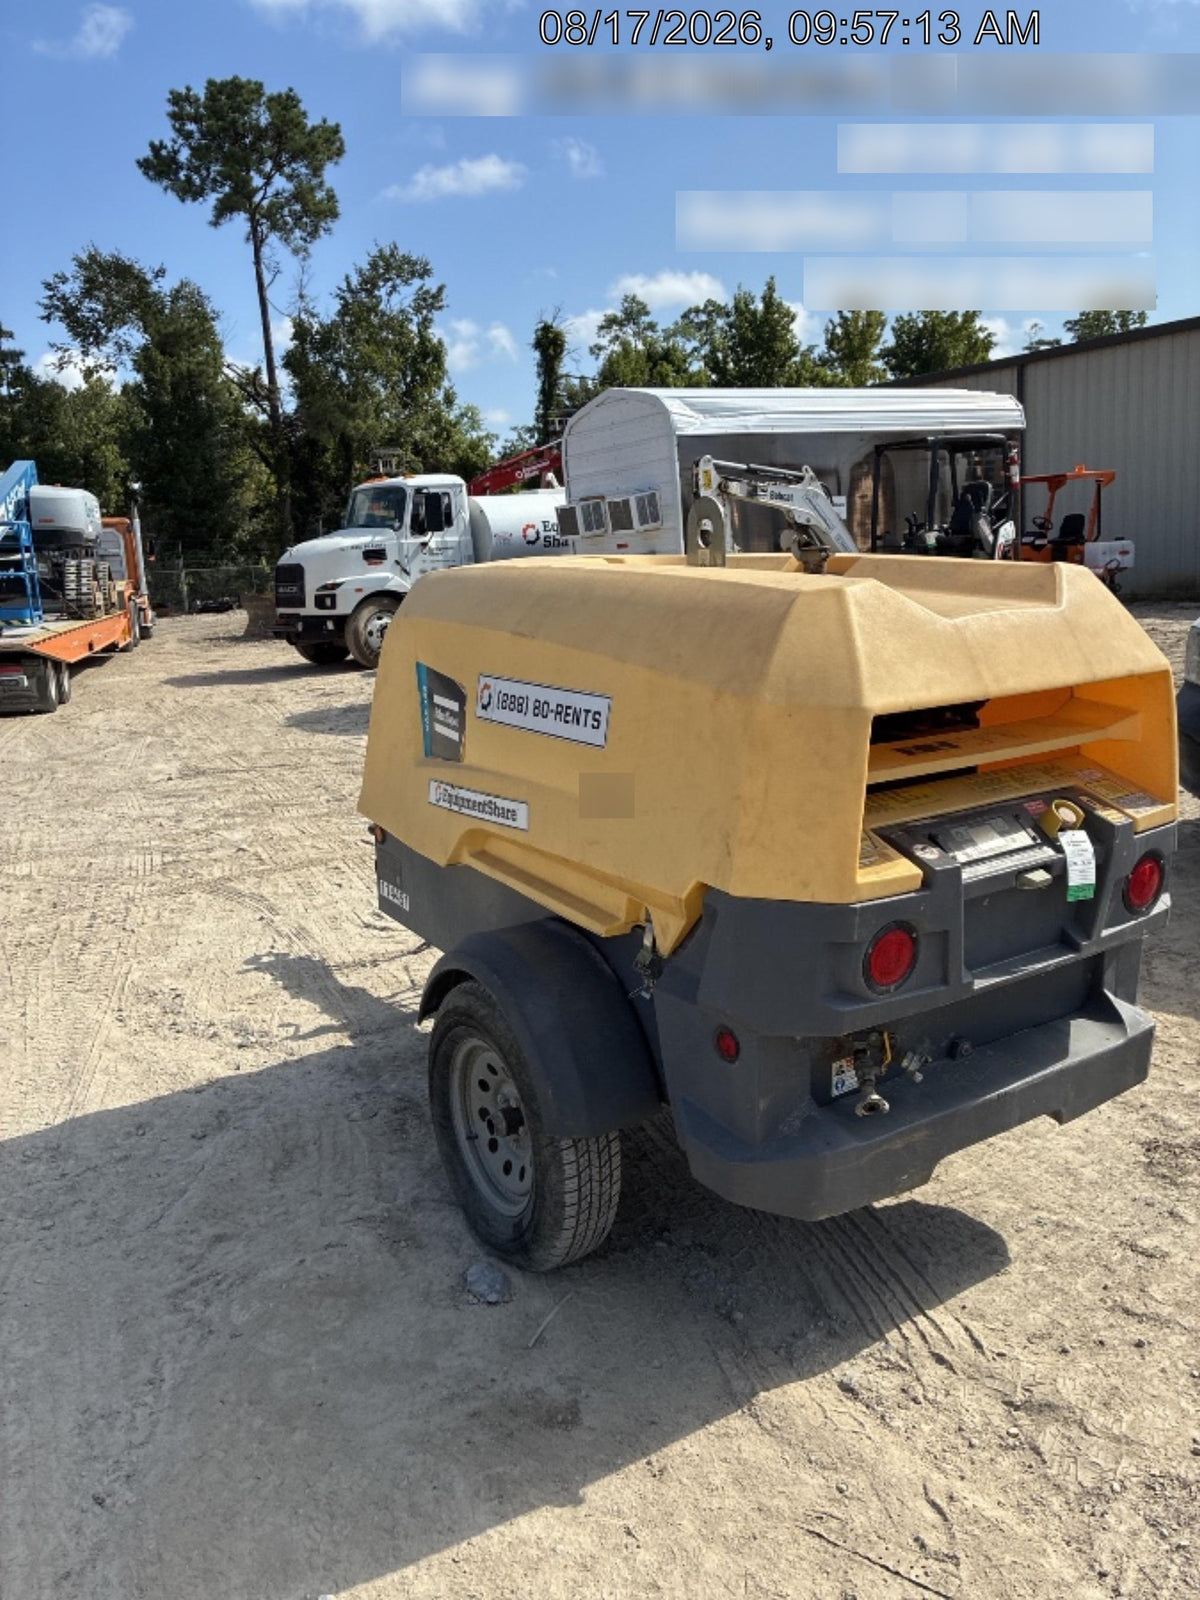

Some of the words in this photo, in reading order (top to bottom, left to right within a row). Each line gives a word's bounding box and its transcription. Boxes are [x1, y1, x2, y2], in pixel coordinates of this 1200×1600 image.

[769, 490, 794, 502] Bobcat
[496, 689, 530, 717] (888)
[532, 697, 602, 730] 80-RENTS
[442, 787, 518, 823] EquipmentShare
